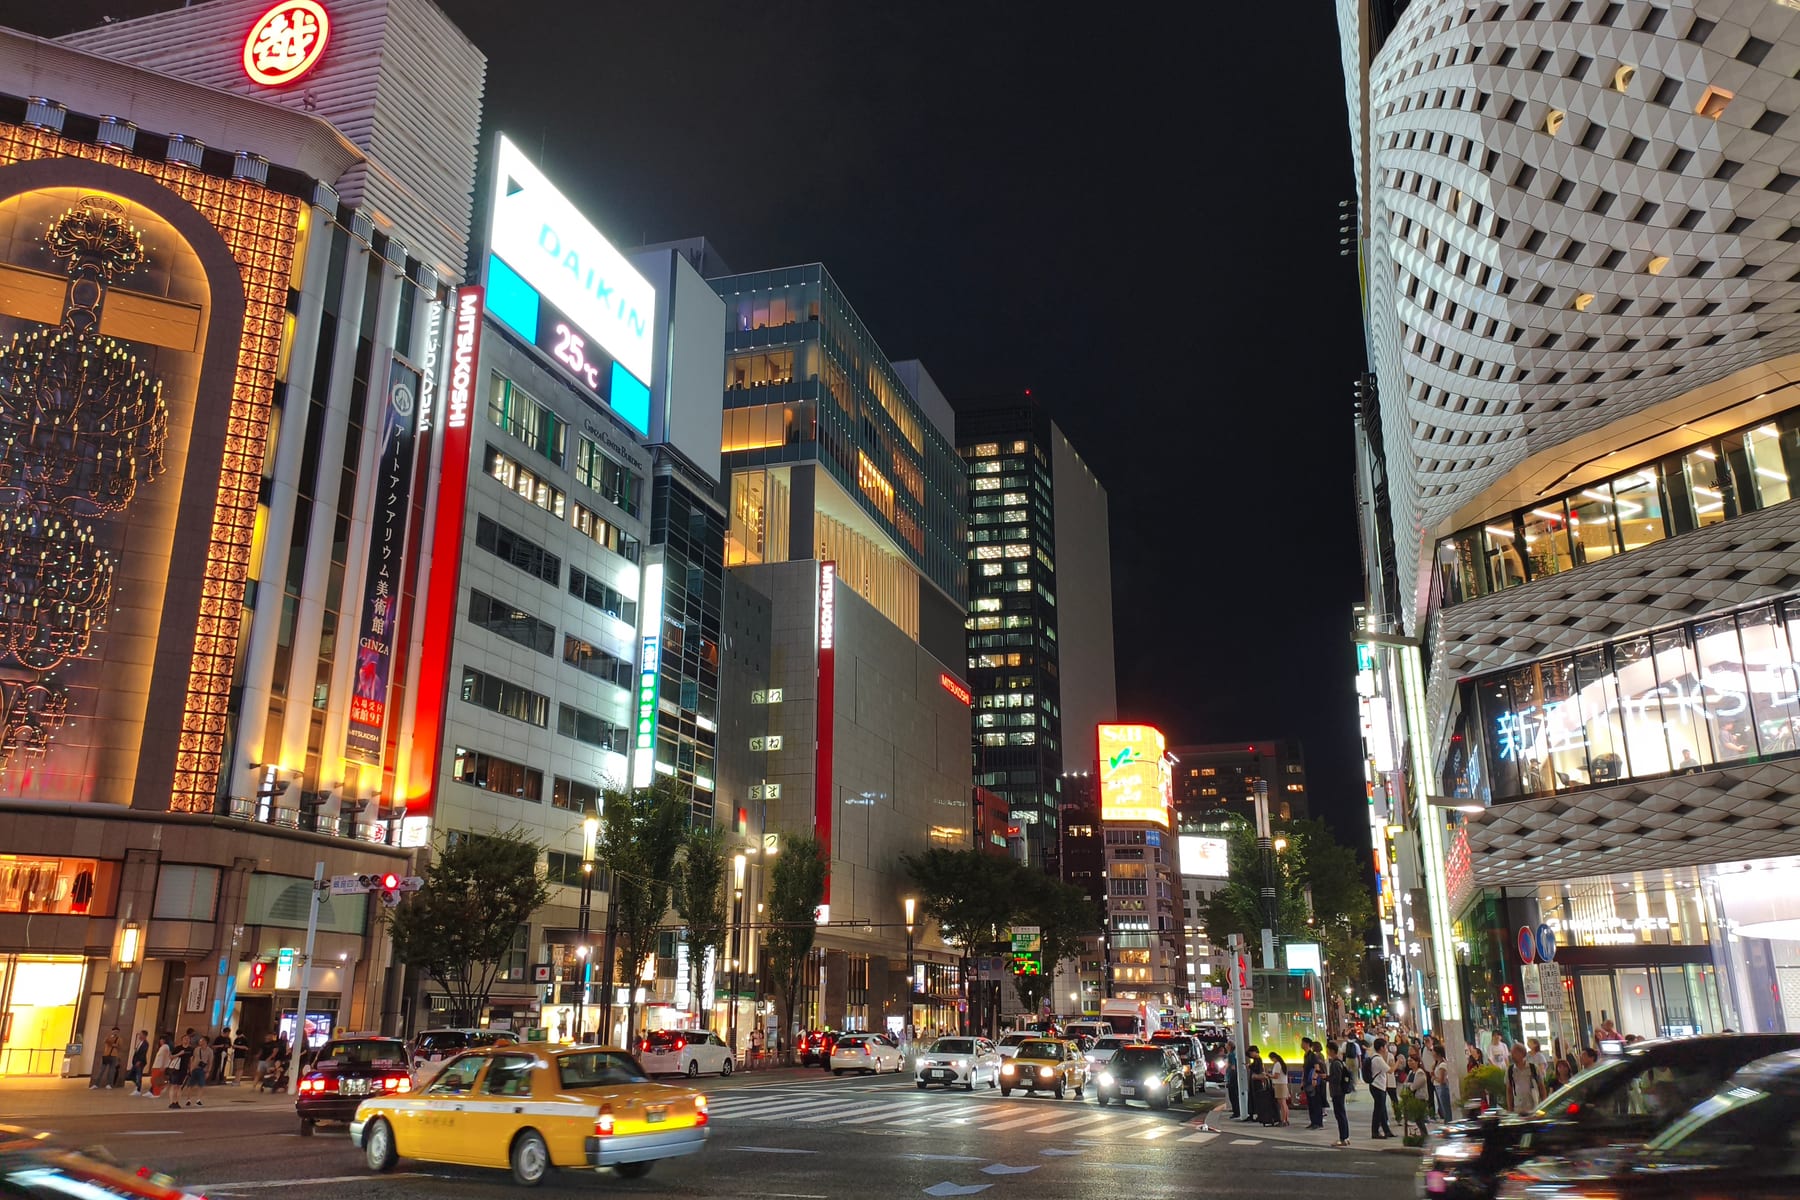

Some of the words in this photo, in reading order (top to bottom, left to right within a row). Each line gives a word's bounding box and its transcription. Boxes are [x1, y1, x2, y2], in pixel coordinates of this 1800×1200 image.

[538, 223, 646, 340] DAIKIN
[449, 294, 477, 427] MITSUKOSHI
[371, 424, 404, 636] アートアクアリウム美術館
[360, 637, 389, 656] GINZA
[820, 565, 834, 649] MITSUKOSHI
[941, 673, 970, 705] MITSUKOSHI
